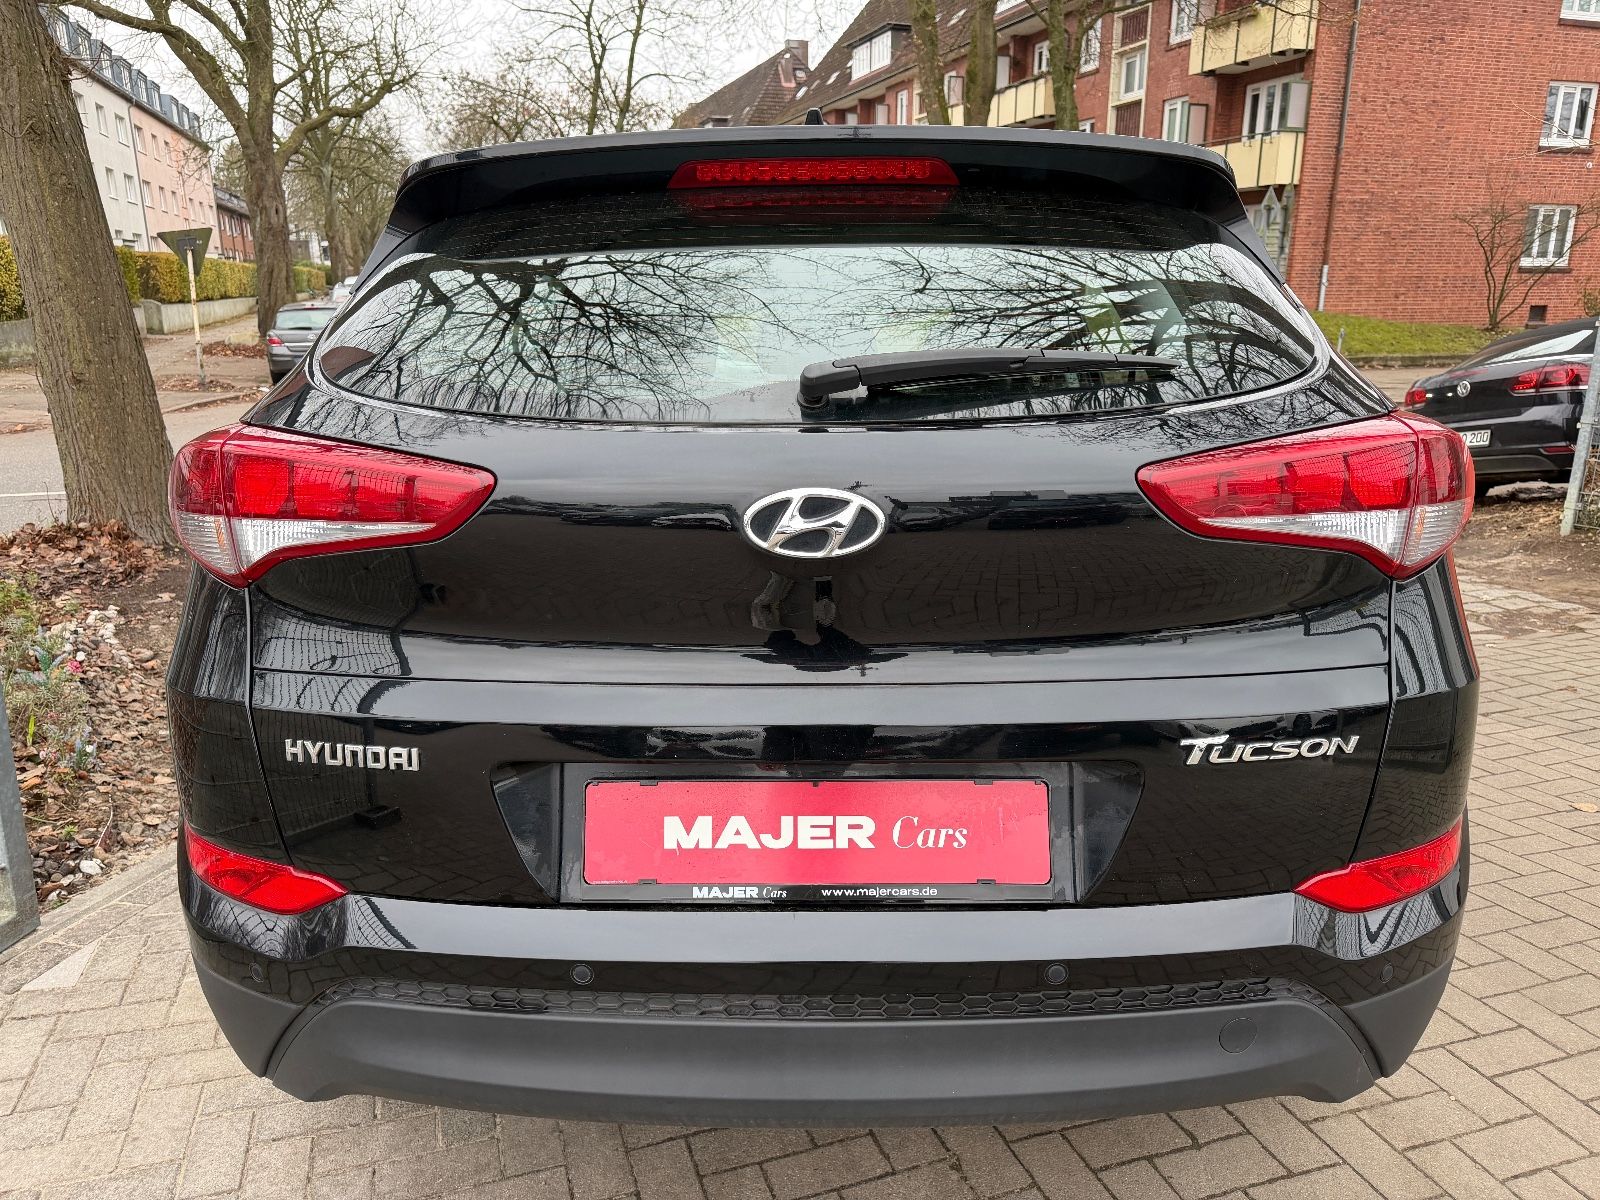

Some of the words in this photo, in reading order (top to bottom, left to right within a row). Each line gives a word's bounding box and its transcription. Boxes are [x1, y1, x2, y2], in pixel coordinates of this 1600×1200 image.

[1470, 431, 1489, 443] 200
[284, 738, 420, 771] HYUNDAI
[1180, 734, 1360, 765] TUCSON
[663, 815, 876, 849] MAJER
[892, 815, 968, 849] Cars
[692, 887, 759, 899] MAJER
[762, 887, 788, 898] Cars
[821, 887, 938, 898] www.majercars.de
